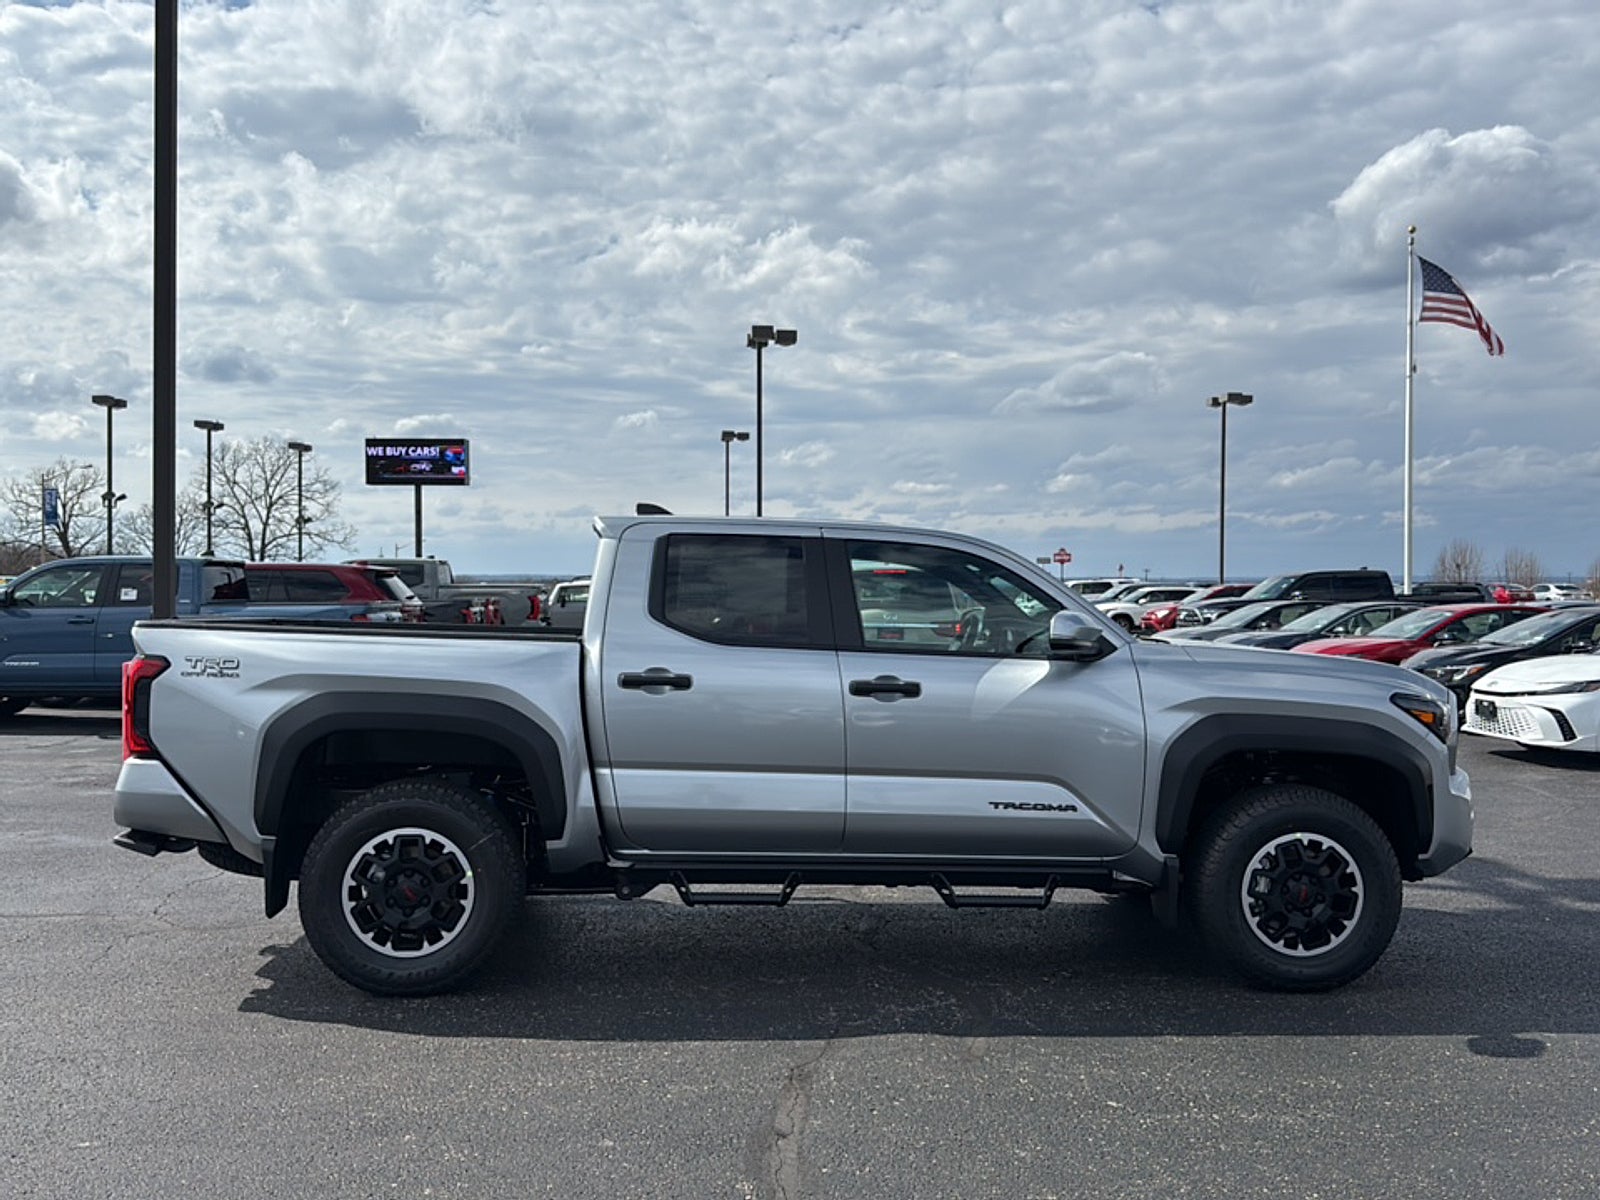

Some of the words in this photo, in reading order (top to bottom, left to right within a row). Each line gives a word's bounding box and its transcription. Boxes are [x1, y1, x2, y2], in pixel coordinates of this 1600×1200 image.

[366, 446, 384, 456] WE
[386, 446, 407, 456] BUY
[408, 446, 440, 457] CARS!
[185, 656, 240, 672] TRD
[988, 801, 1078, 813] TACOMA
